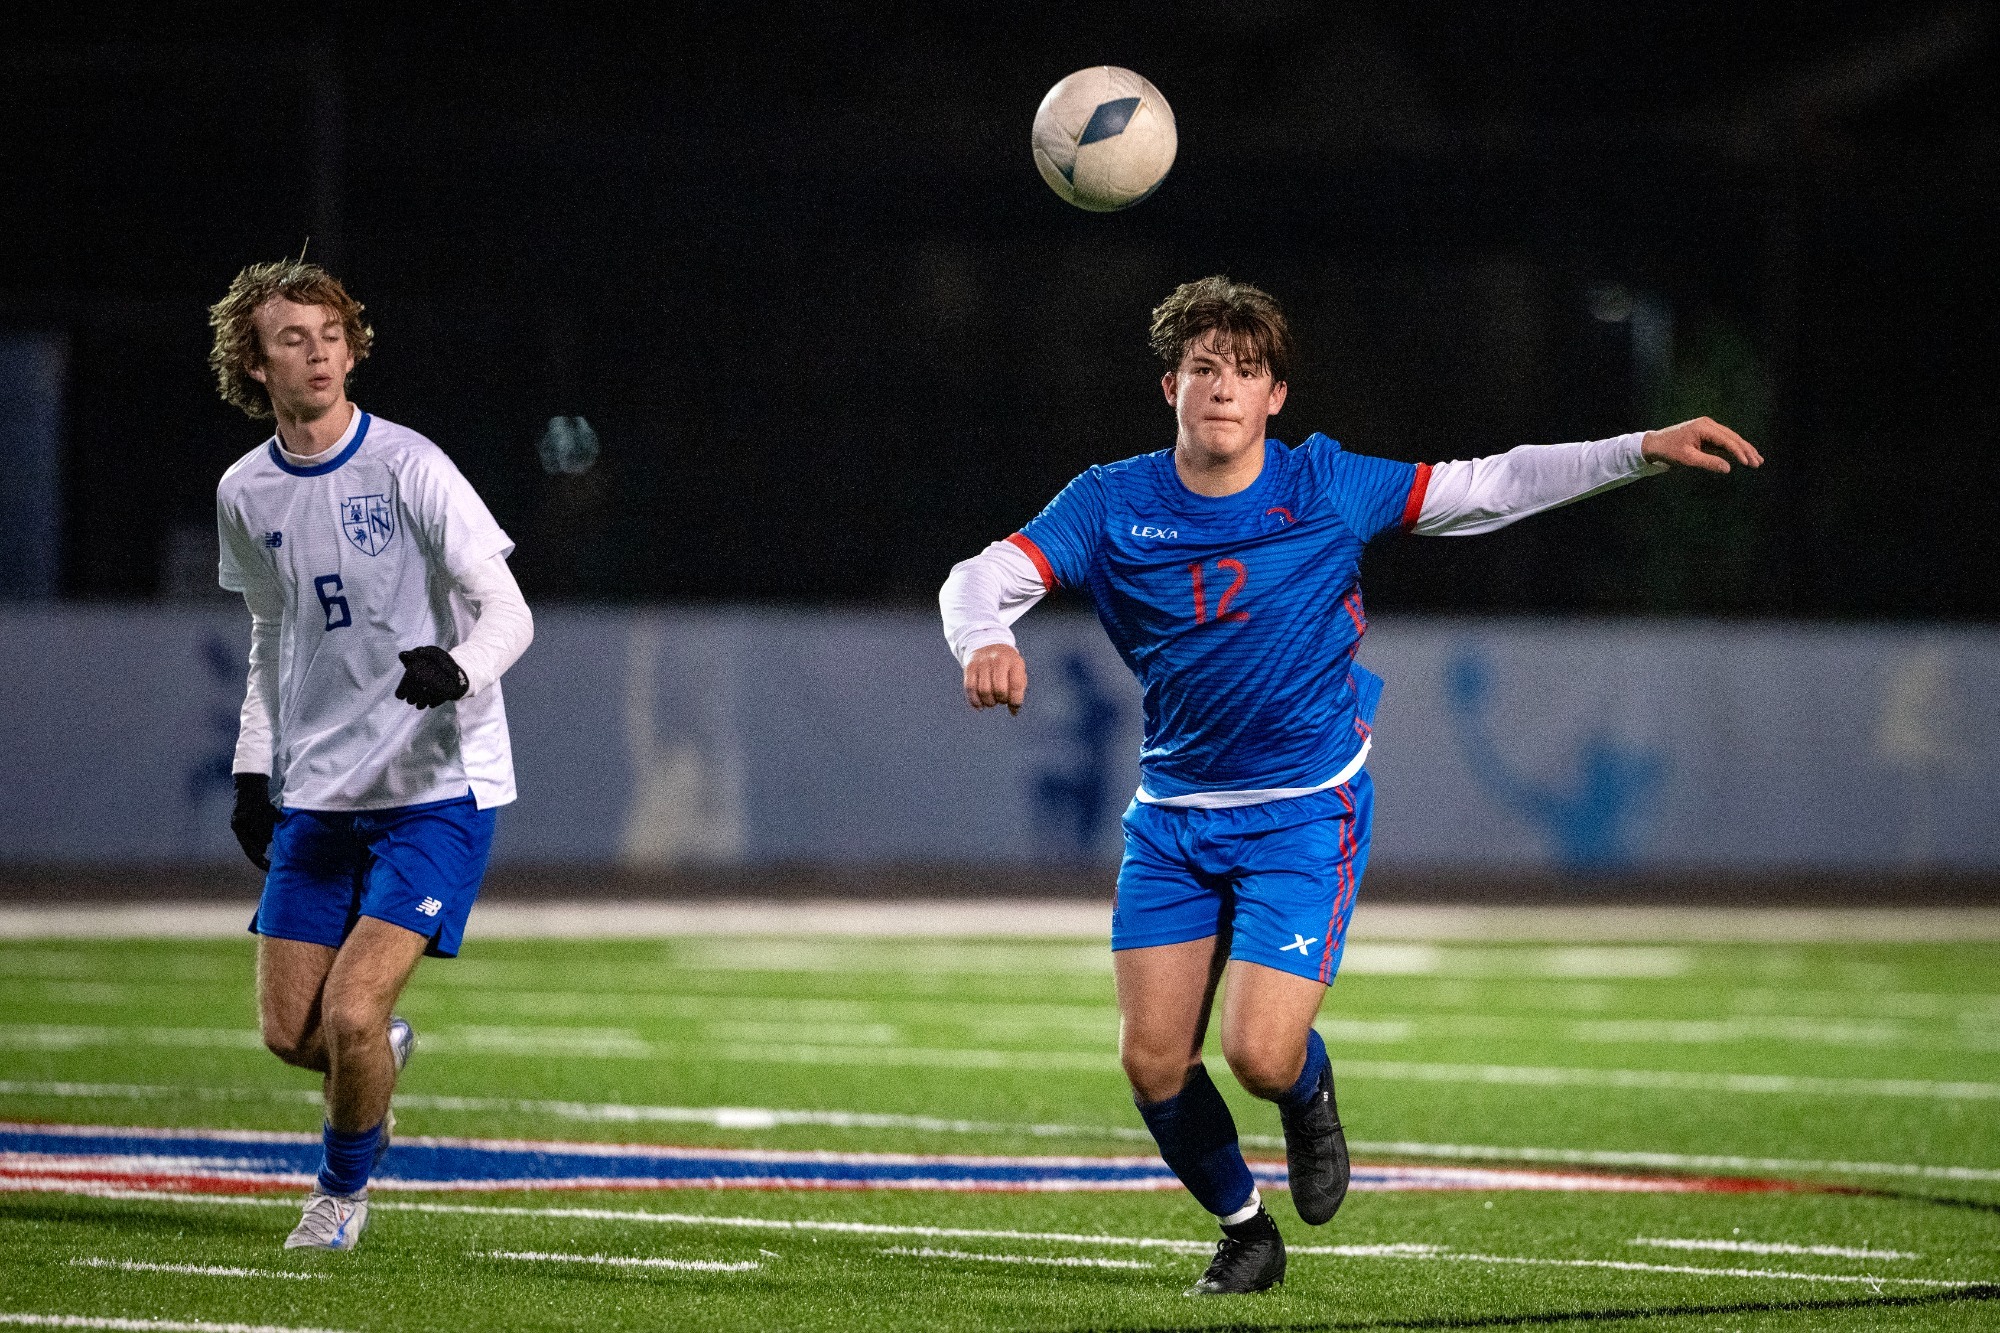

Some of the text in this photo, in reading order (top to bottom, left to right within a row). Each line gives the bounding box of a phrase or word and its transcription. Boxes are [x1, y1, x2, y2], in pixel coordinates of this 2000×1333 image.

[370, 511, 391, 534] N
[314, 574, 351, 631] 6
[1188, 558, 1249, 624] 12
